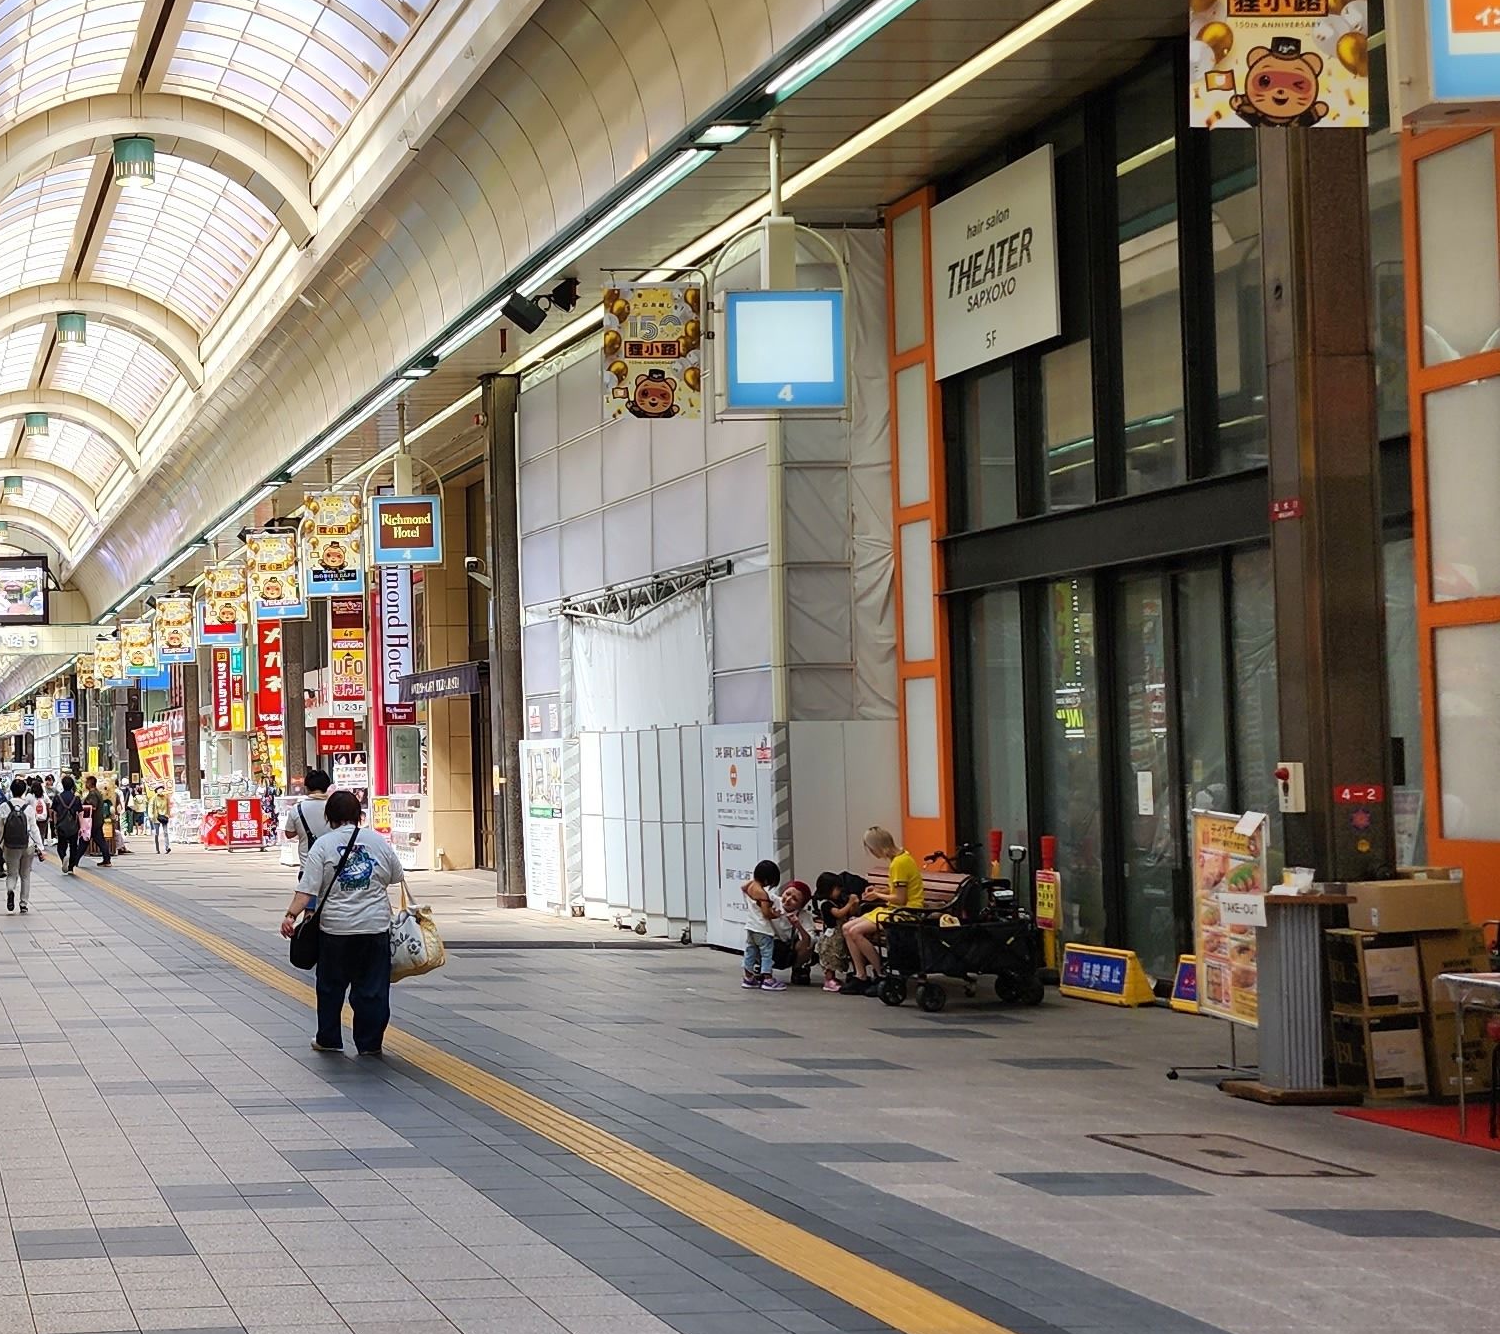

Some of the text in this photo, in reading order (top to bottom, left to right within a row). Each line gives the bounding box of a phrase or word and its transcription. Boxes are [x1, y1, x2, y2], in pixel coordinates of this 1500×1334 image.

[966, 207, 1010, 240] hair salon
[947, 226, 1034, 299] THEATER
[966, 276, 1017, 313] SAPXOXO
[985, 329, 997, 349] 5F
[778, 383, 794, 402] 4
[380, 512, 431, 526] Richmond
[393, 526, 420, 539] Hotel
[403, 549, 411, 559] 4
[28, 633, 38, 648] 5
[334, 658, 364, 675] UFO
[334, 683, 365, 696] 専門店
[1222, 901, 1259, 916] TAKE-OUT
